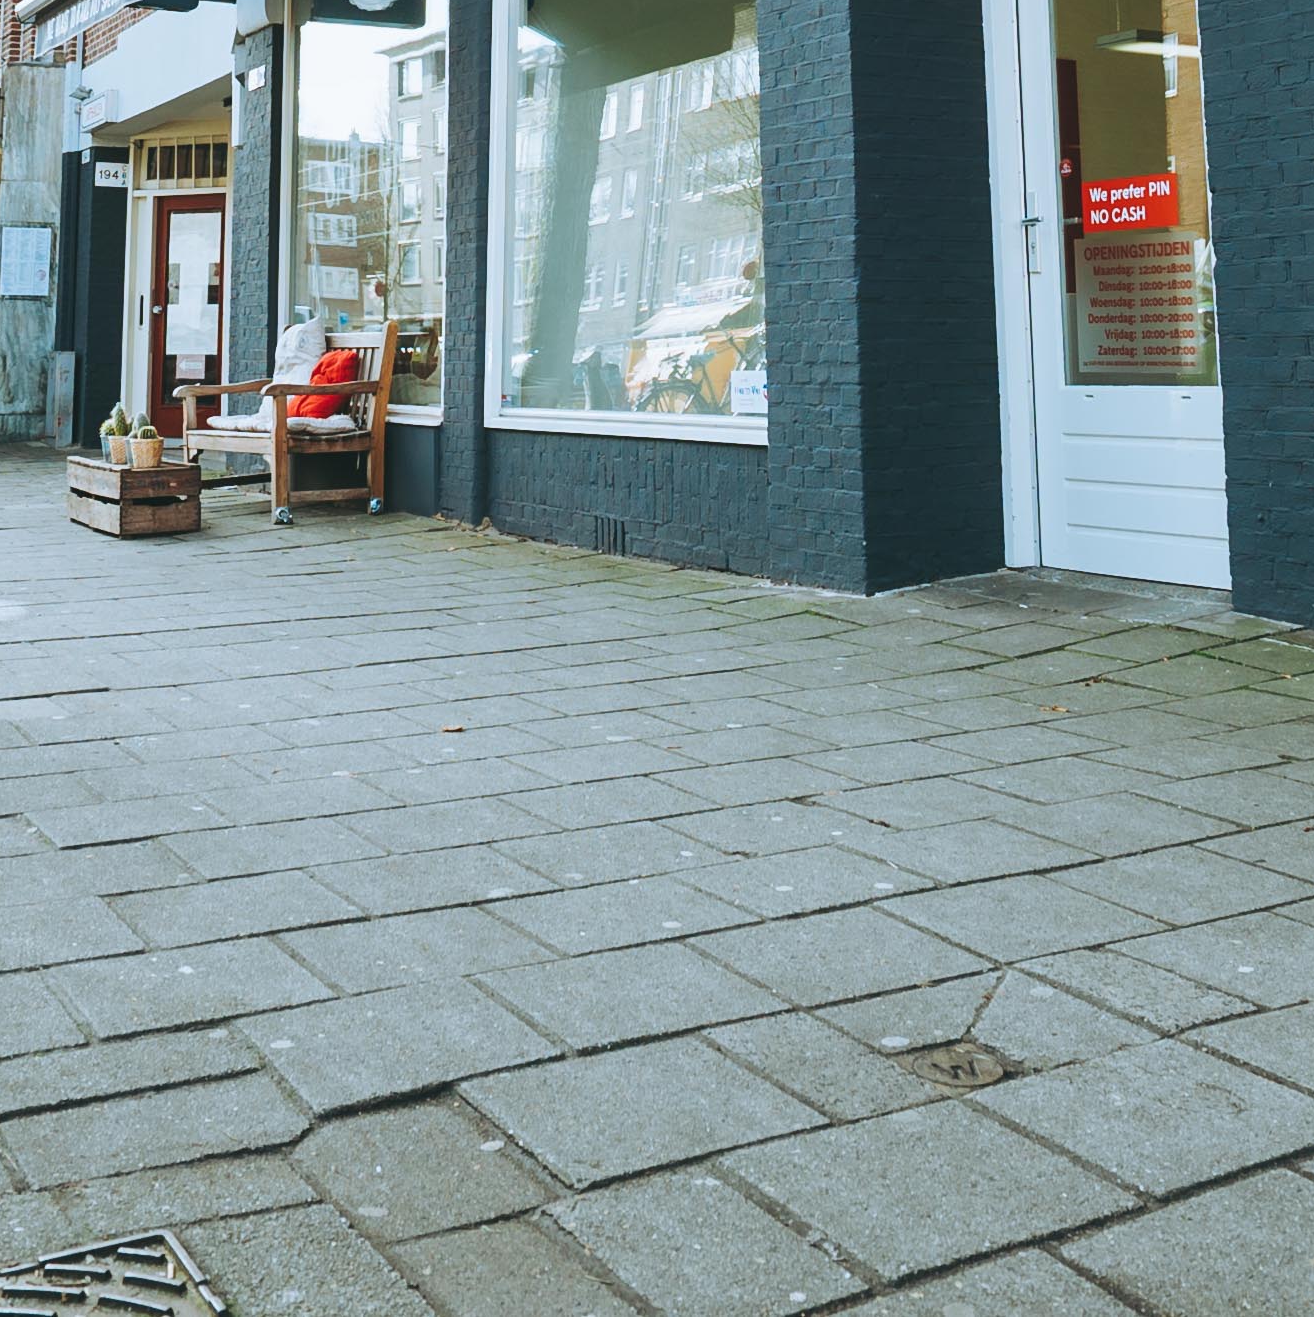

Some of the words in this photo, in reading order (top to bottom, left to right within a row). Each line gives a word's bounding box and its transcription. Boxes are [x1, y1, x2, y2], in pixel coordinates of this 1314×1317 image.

[99, 169, 119, 180] 194
[1089, 187, 1107, 203] We
[1110, 184, 1146, 204] prefer
[1149, 180, 1170, 197] PIN
[1090, 208, 1109, 225] NO
[1112, 205, 1146, 223] CASH
[1084, 241, 1190, 261] OPENINGSTIJDEN
